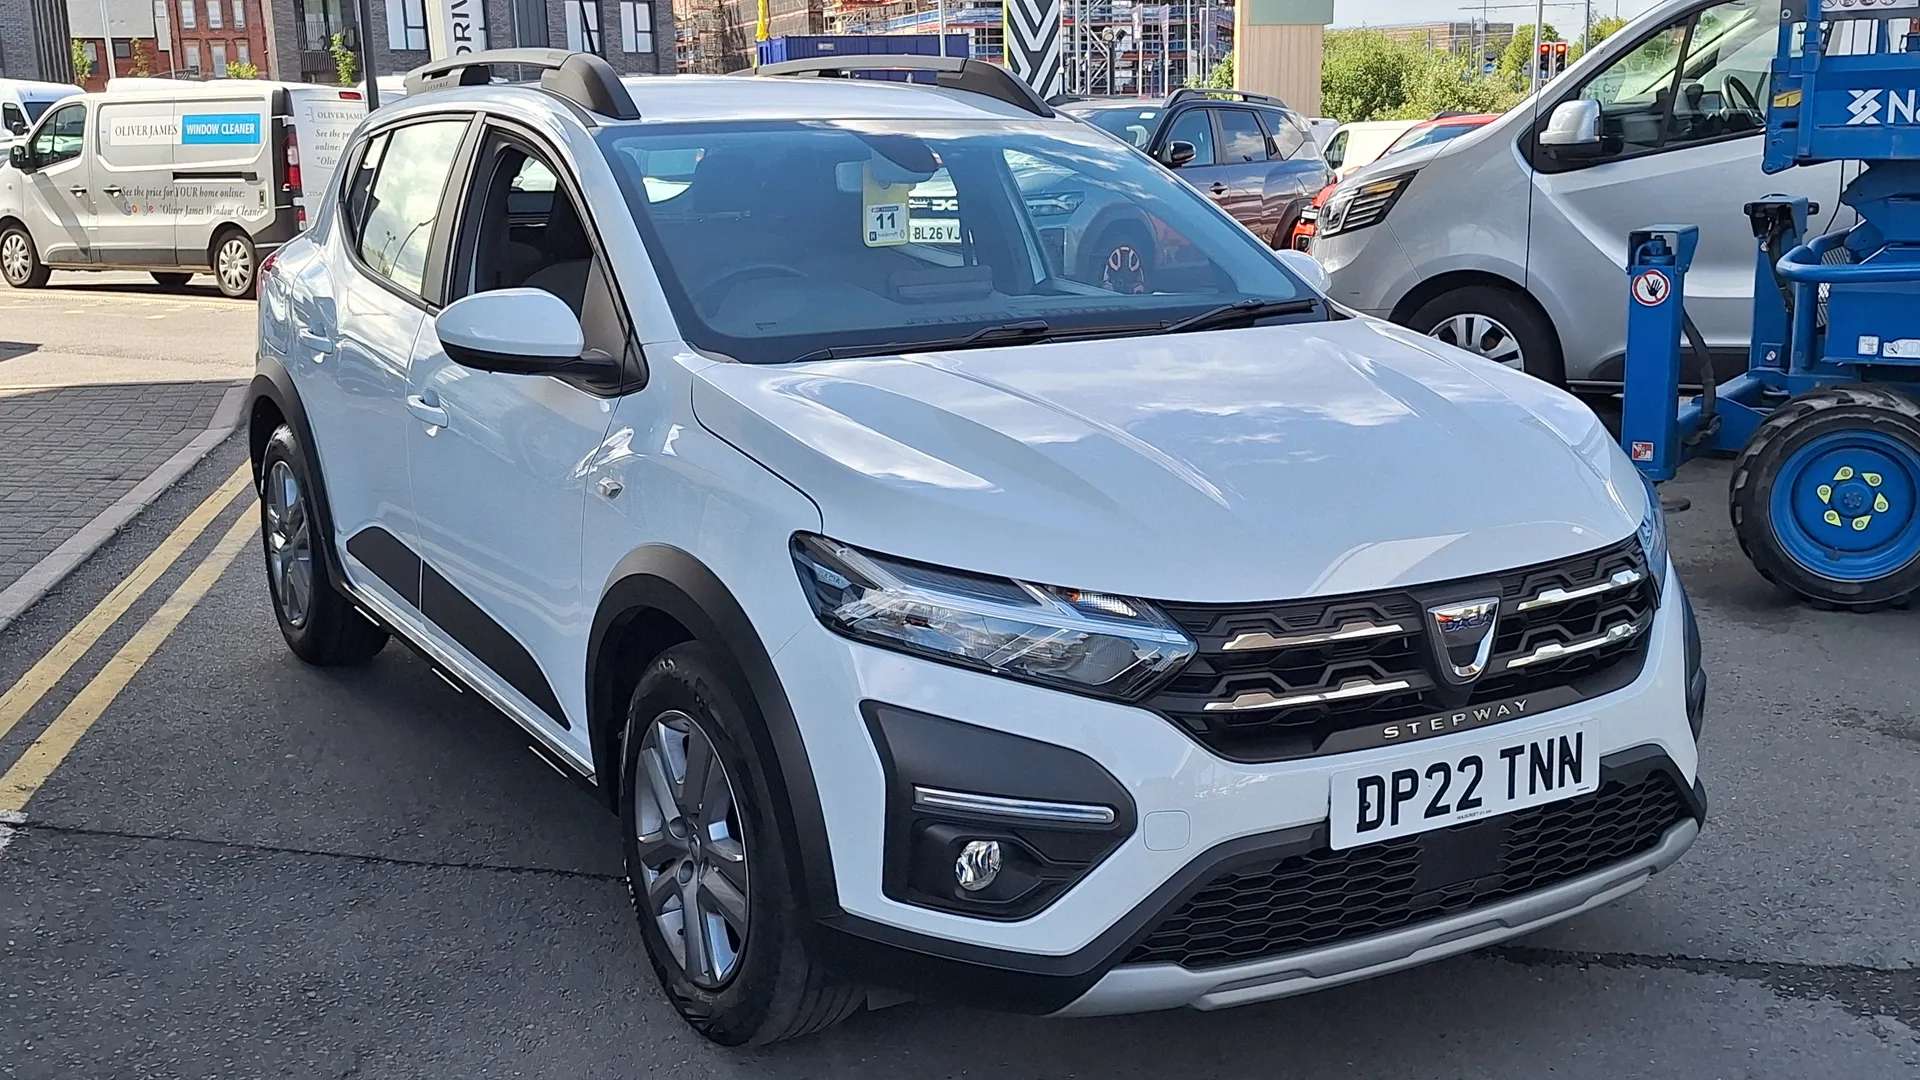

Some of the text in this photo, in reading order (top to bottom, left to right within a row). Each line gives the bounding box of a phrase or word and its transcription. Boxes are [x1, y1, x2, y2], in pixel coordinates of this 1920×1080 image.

[317, 111, 345, 120] OLIVER
[115, 123, 178, 138] OLIVER JAMES
[186, 122, 256, 135] WINDOW CLEANER
[121, 186, 132, 197] See
[133, 185, 144, 197] the
[145, 187, 162, 199] price
[162, 186, 174, 200] for
[174, 186, 199, 198] YOUR
[200, 185, 219, 198] home
[124, 201, 154, 216] Gogle
[876, 212, 896, 230] 11
[914, 226, 943, 240] BL26
[1383, 699, 1528, 739] STEPWAY
[1356, 731, 1584, 833] DP22 TNN
